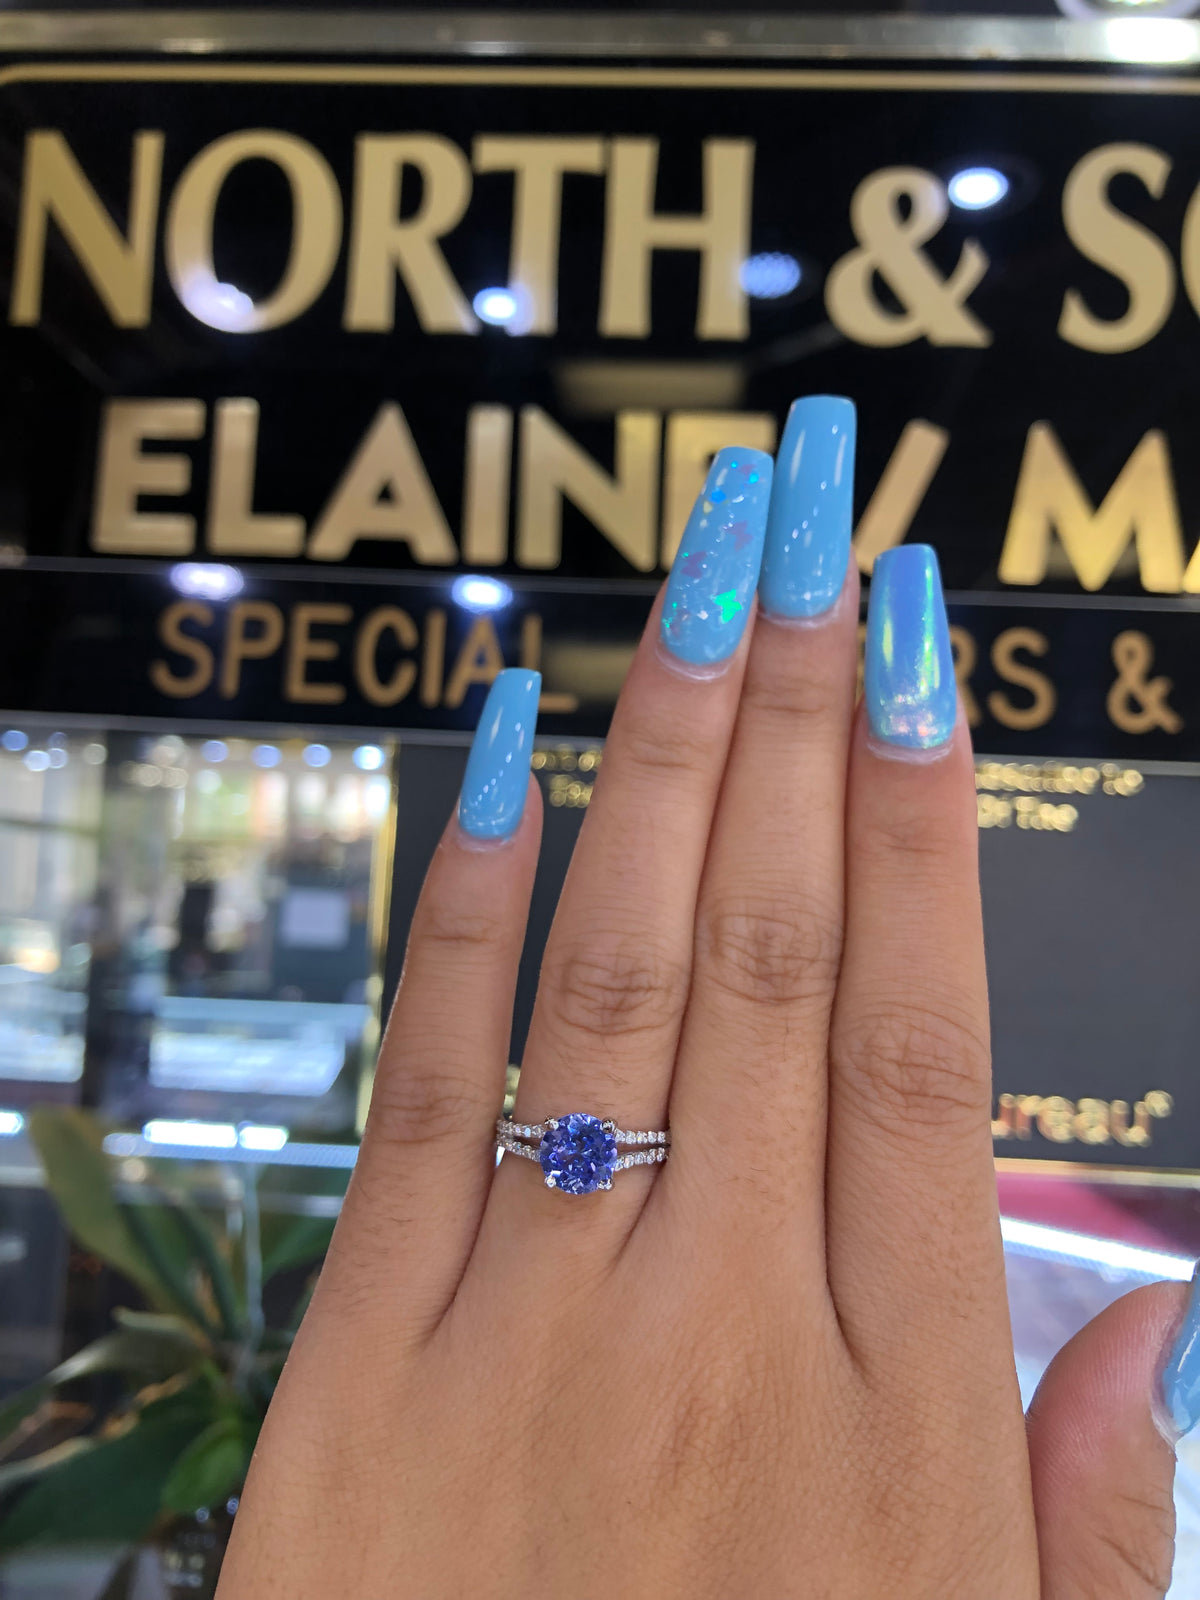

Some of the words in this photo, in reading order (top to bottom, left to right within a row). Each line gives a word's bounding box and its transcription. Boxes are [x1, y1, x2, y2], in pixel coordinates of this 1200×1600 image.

[8, 128, 756, 341] NORTH
[824, 164, 993, 348] &
[1057, 140, 1200, 355] S
[998, 418, 1200, 594] M
[1107, 629, 1184, 734] &
